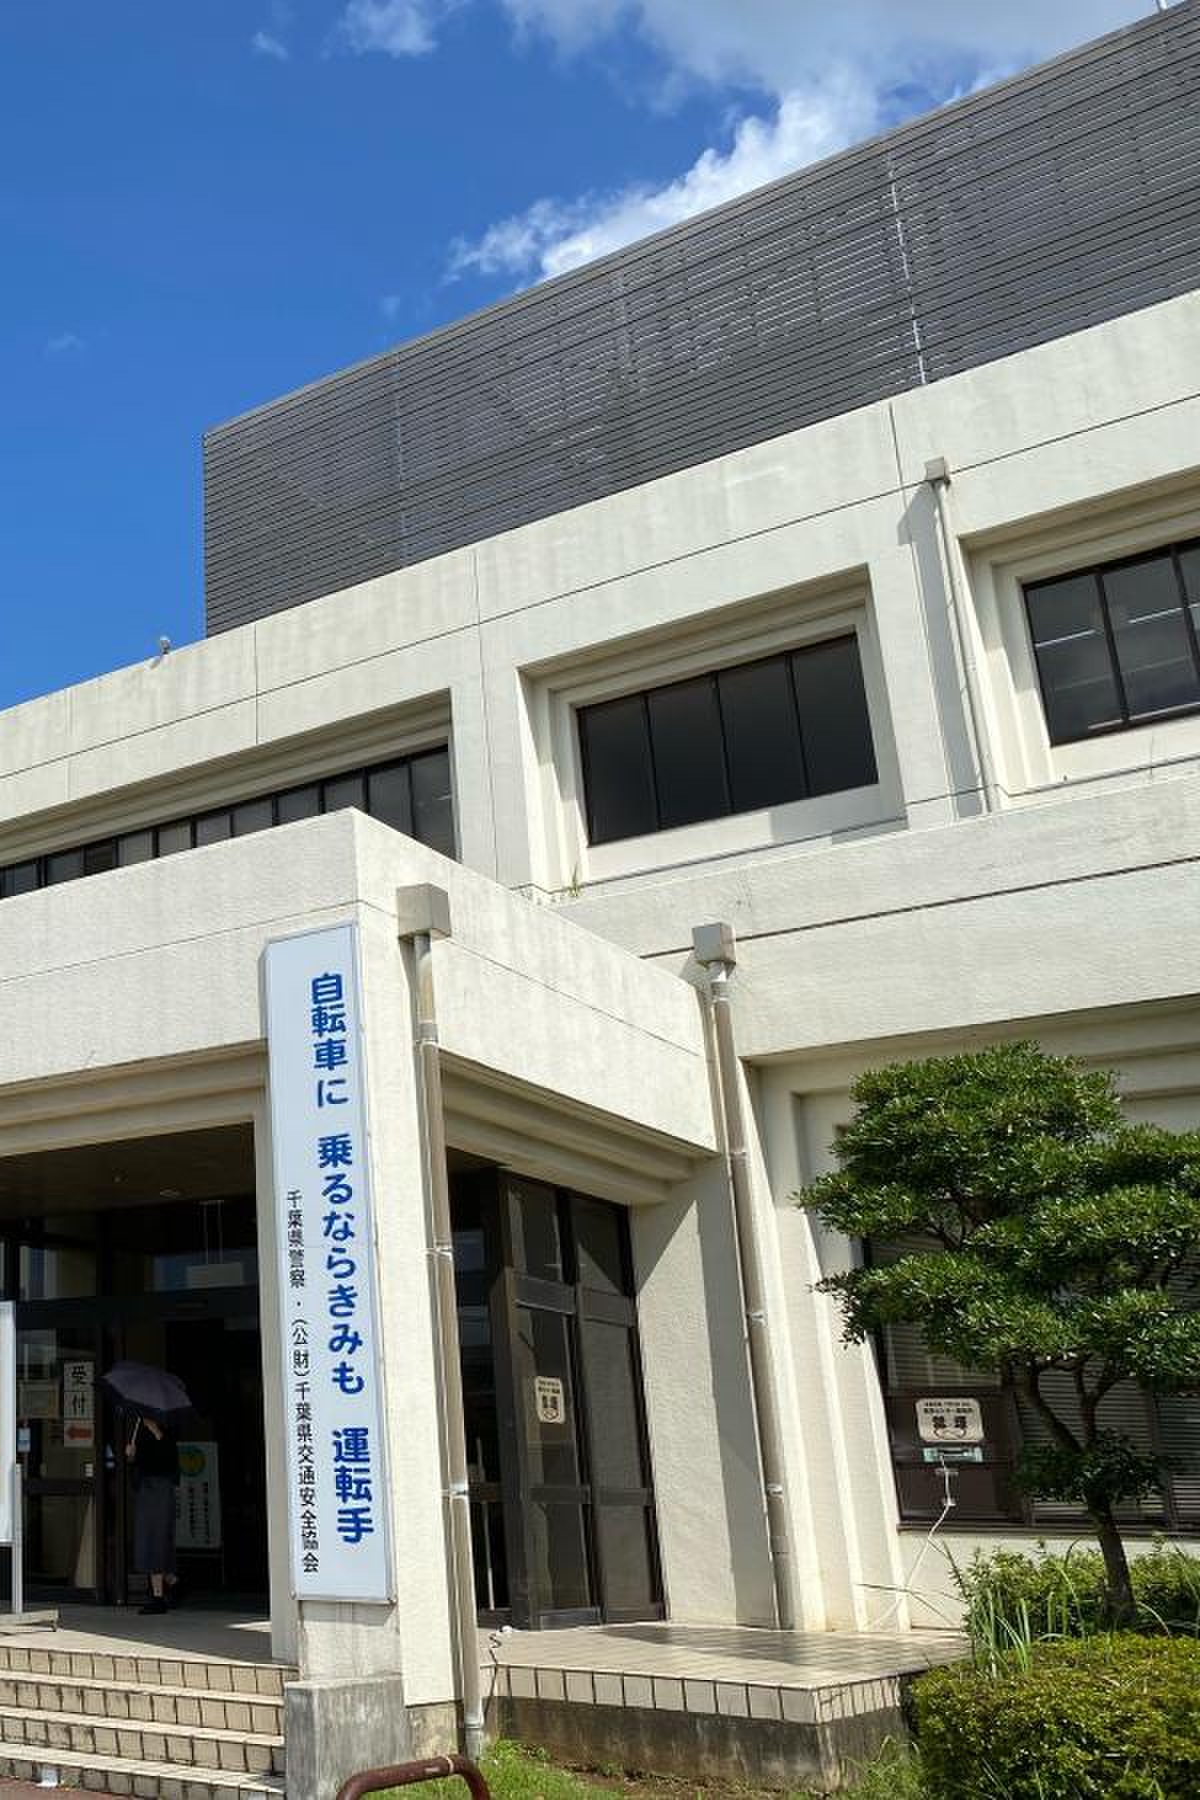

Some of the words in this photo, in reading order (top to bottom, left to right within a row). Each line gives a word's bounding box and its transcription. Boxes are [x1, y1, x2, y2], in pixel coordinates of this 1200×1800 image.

[311, 973, 348, 1108] 自転車に
[318, 1134, 365, 1395] 乗るならきみも
[71, 1365, 88, 1416] 受付
[332, 1427, 374, 1544] 運転手
